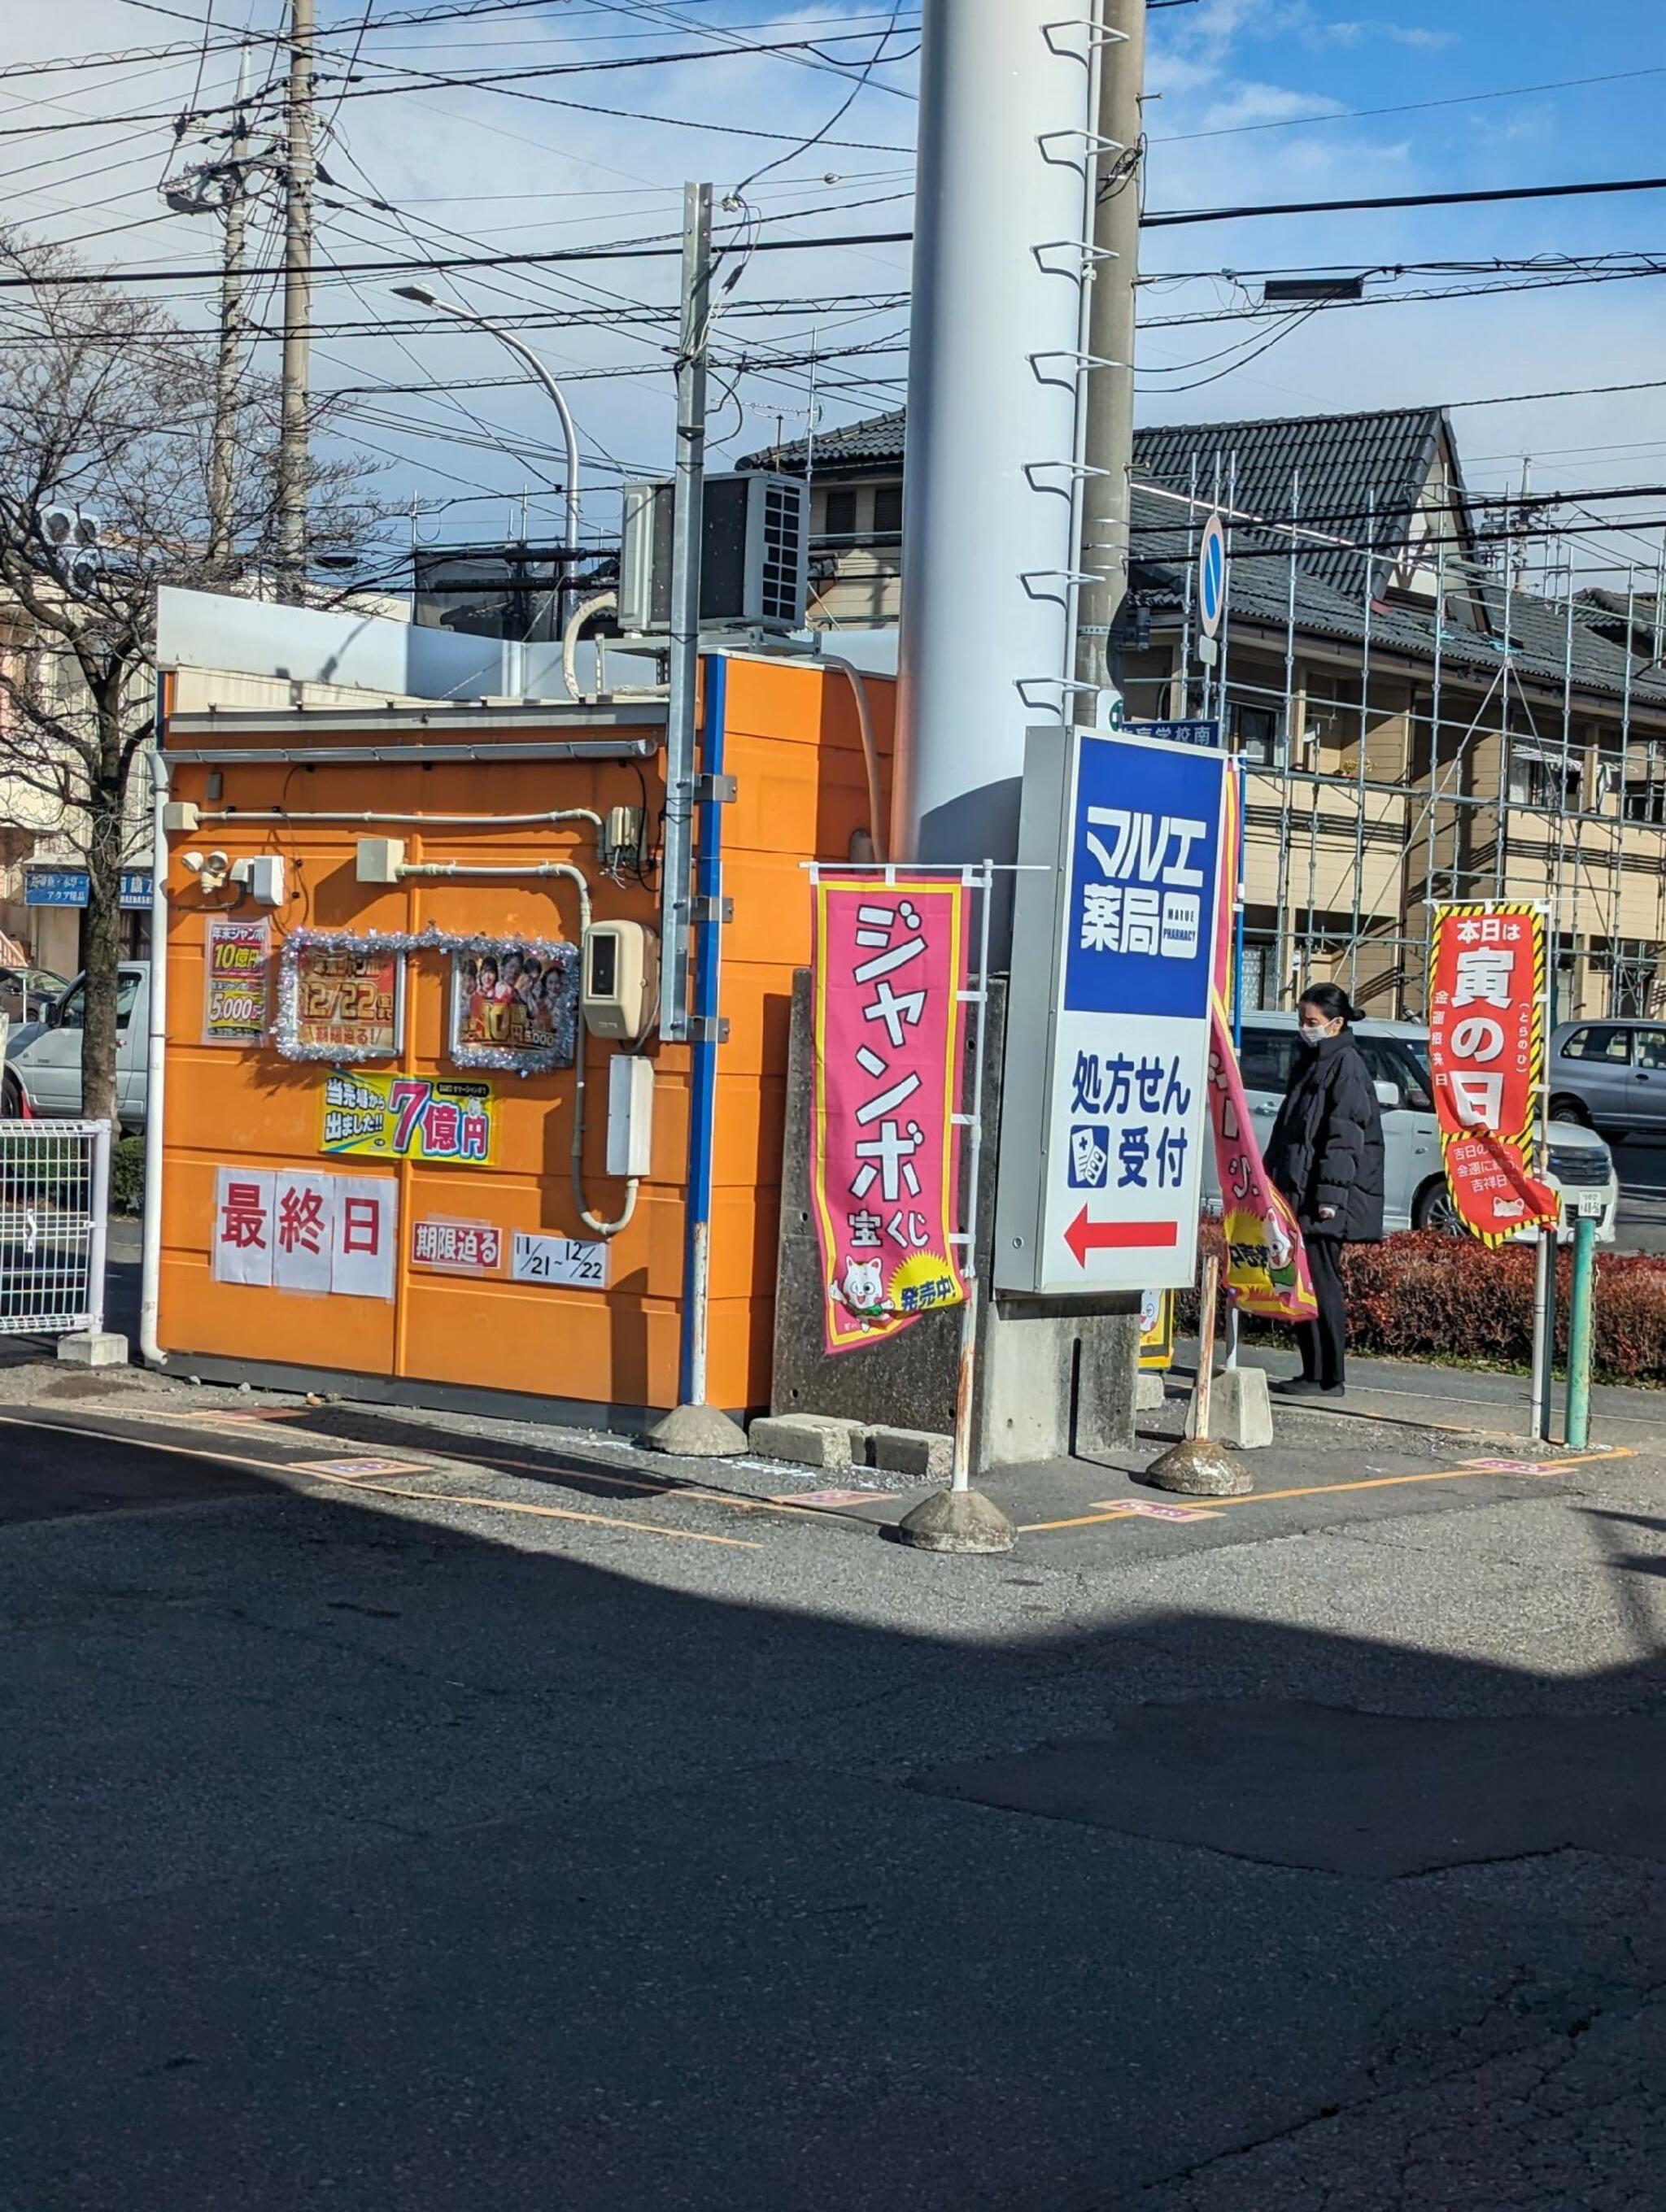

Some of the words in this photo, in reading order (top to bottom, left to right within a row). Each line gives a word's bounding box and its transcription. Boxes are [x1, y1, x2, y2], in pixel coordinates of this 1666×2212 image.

[1124, 726, 1210, 746] 学校南
[1087, 806, 1206, 887] マルエ
[1080, 883, 1160, 956] 薬局
[1162, 928, 1196, 943] PHARMACY
[1457, 919, 1521, 944] 本日は
[848, 900, 927, 1201] ジャンボ
[1450, 946, 1515, 1130] 寅の日
[327, 1078, 386, 1109] 当売場から
[1071, 1050, 1191, 1116] 処方せん
[390, 1080, 488, 1159] 7億円
[1118, 1126, 1187, 1188] 受付
[220, 1182, 379, 1256] 最終日
[416, 1226, 498, 1263] 期限迫る
[848, 1209, 929, 1249] 宝くじ
